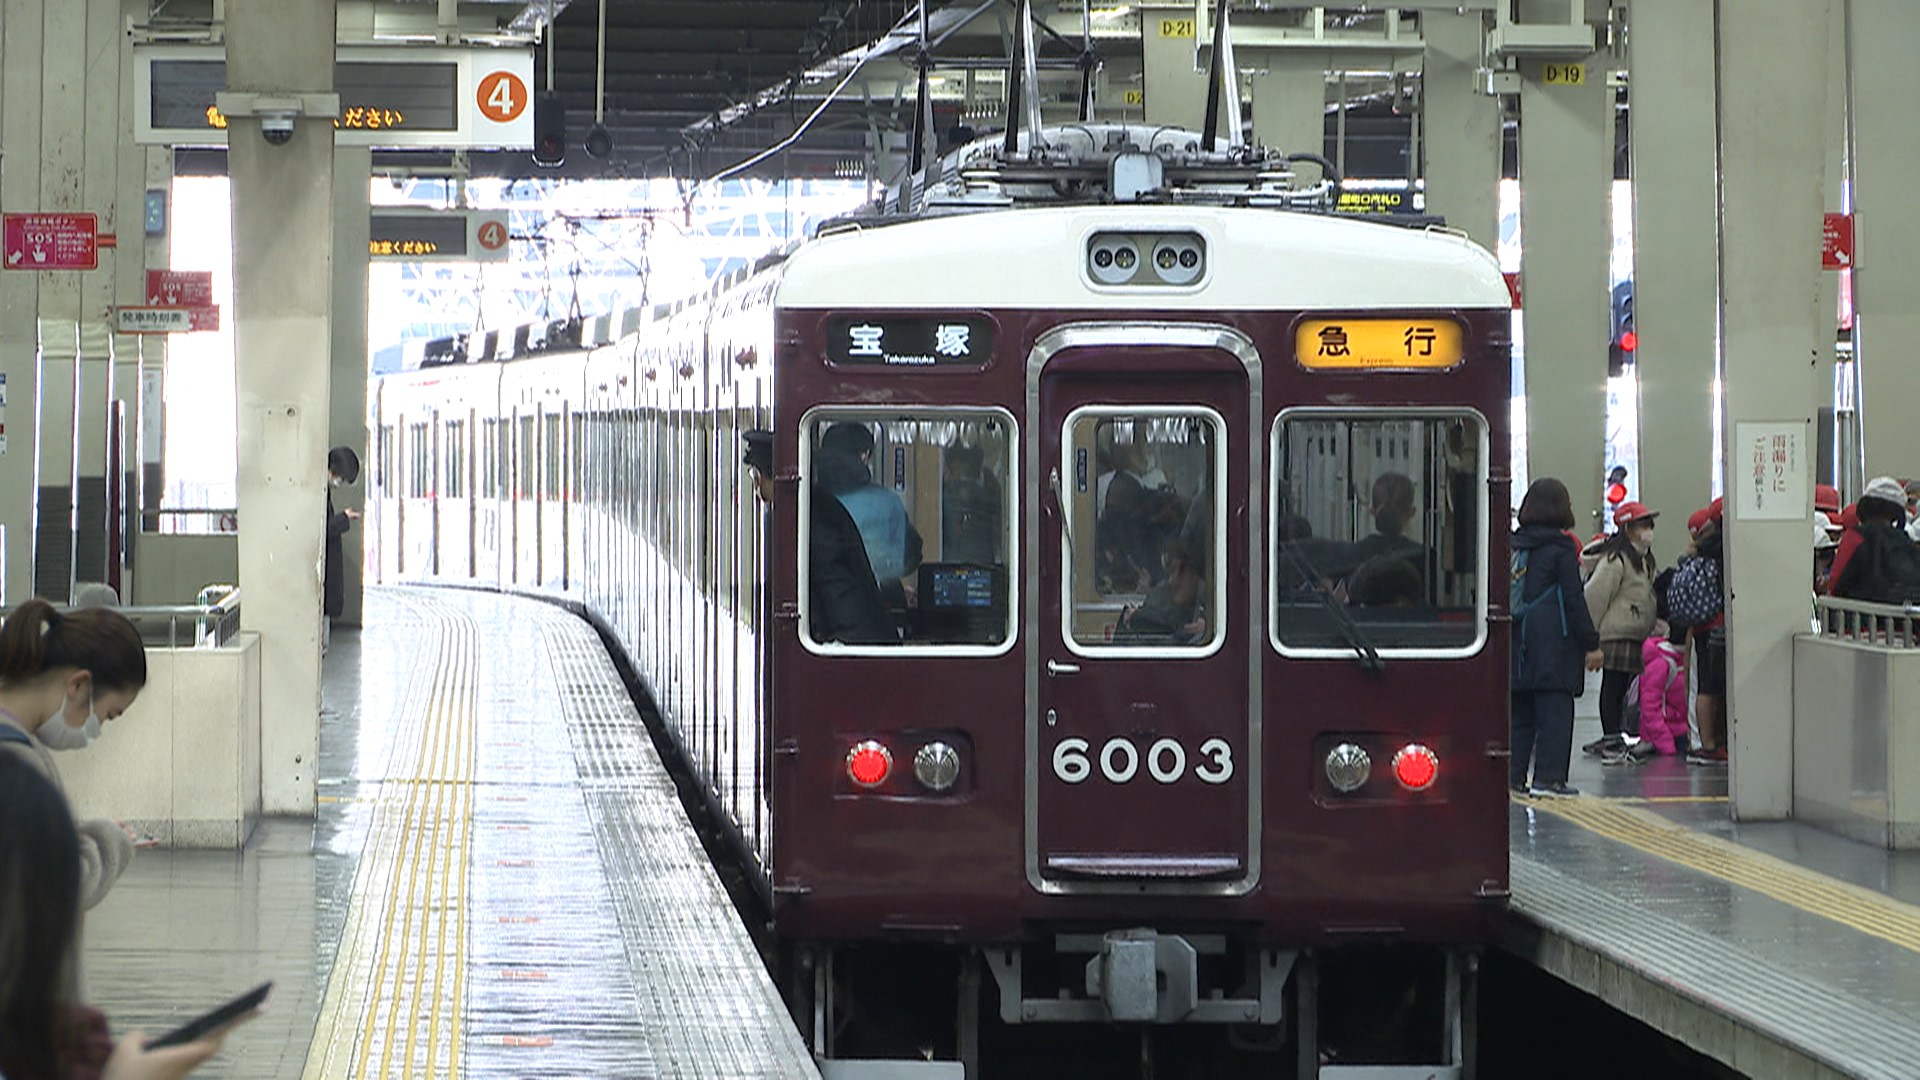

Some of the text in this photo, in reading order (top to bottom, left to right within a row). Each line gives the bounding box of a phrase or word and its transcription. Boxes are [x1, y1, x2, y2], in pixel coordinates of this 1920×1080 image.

[487, 78, 514, 115] 4
[26, 232, 53, 244] SOS
[484, 223, 500, 247] 4
[848, 323, 970, 357] 宝塚
[1318, 325, 1437, 357] 急行
[1052, 737, 1235, 784] 6003
